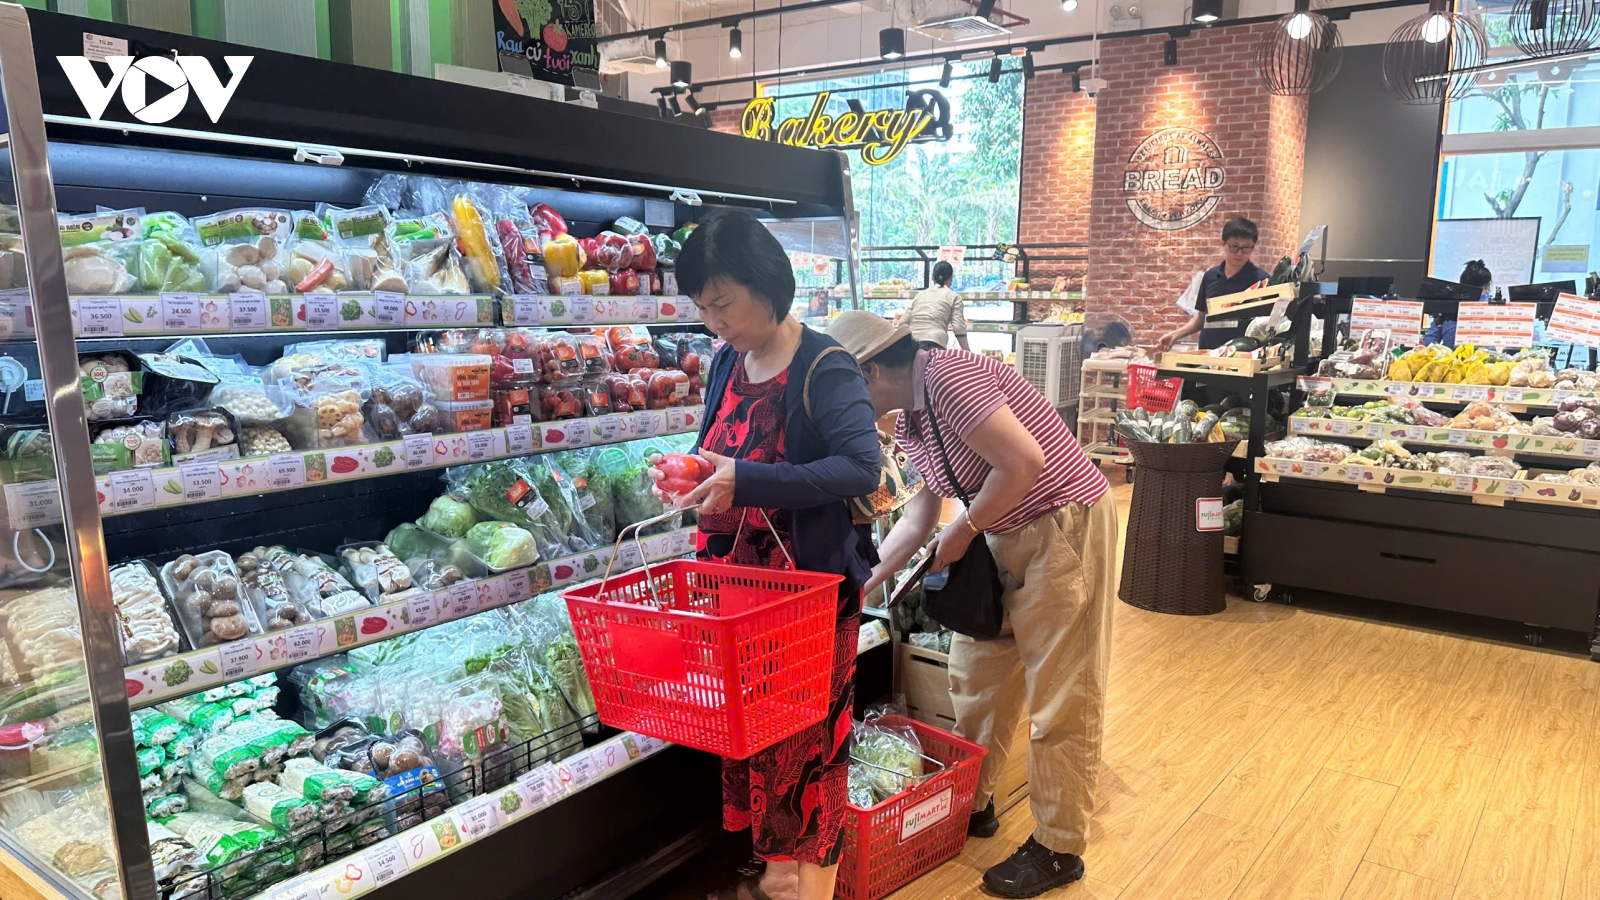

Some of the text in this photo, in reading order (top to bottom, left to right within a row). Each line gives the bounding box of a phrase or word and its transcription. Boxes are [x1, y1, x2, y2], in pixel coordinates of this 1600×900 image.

[497, 31, 524, 53] Rau
[569, 44, 600, 68] xanh
[740, 91, 932, 165] Bakery
[1123, 167, 1225, 191] BREAD
[122, 486, 144, 494] 34.000
[28, 498, 53, 506] 31.000
[294, 638, 312, 647] 62.000
[378, 854, 396, 867] 14.500
